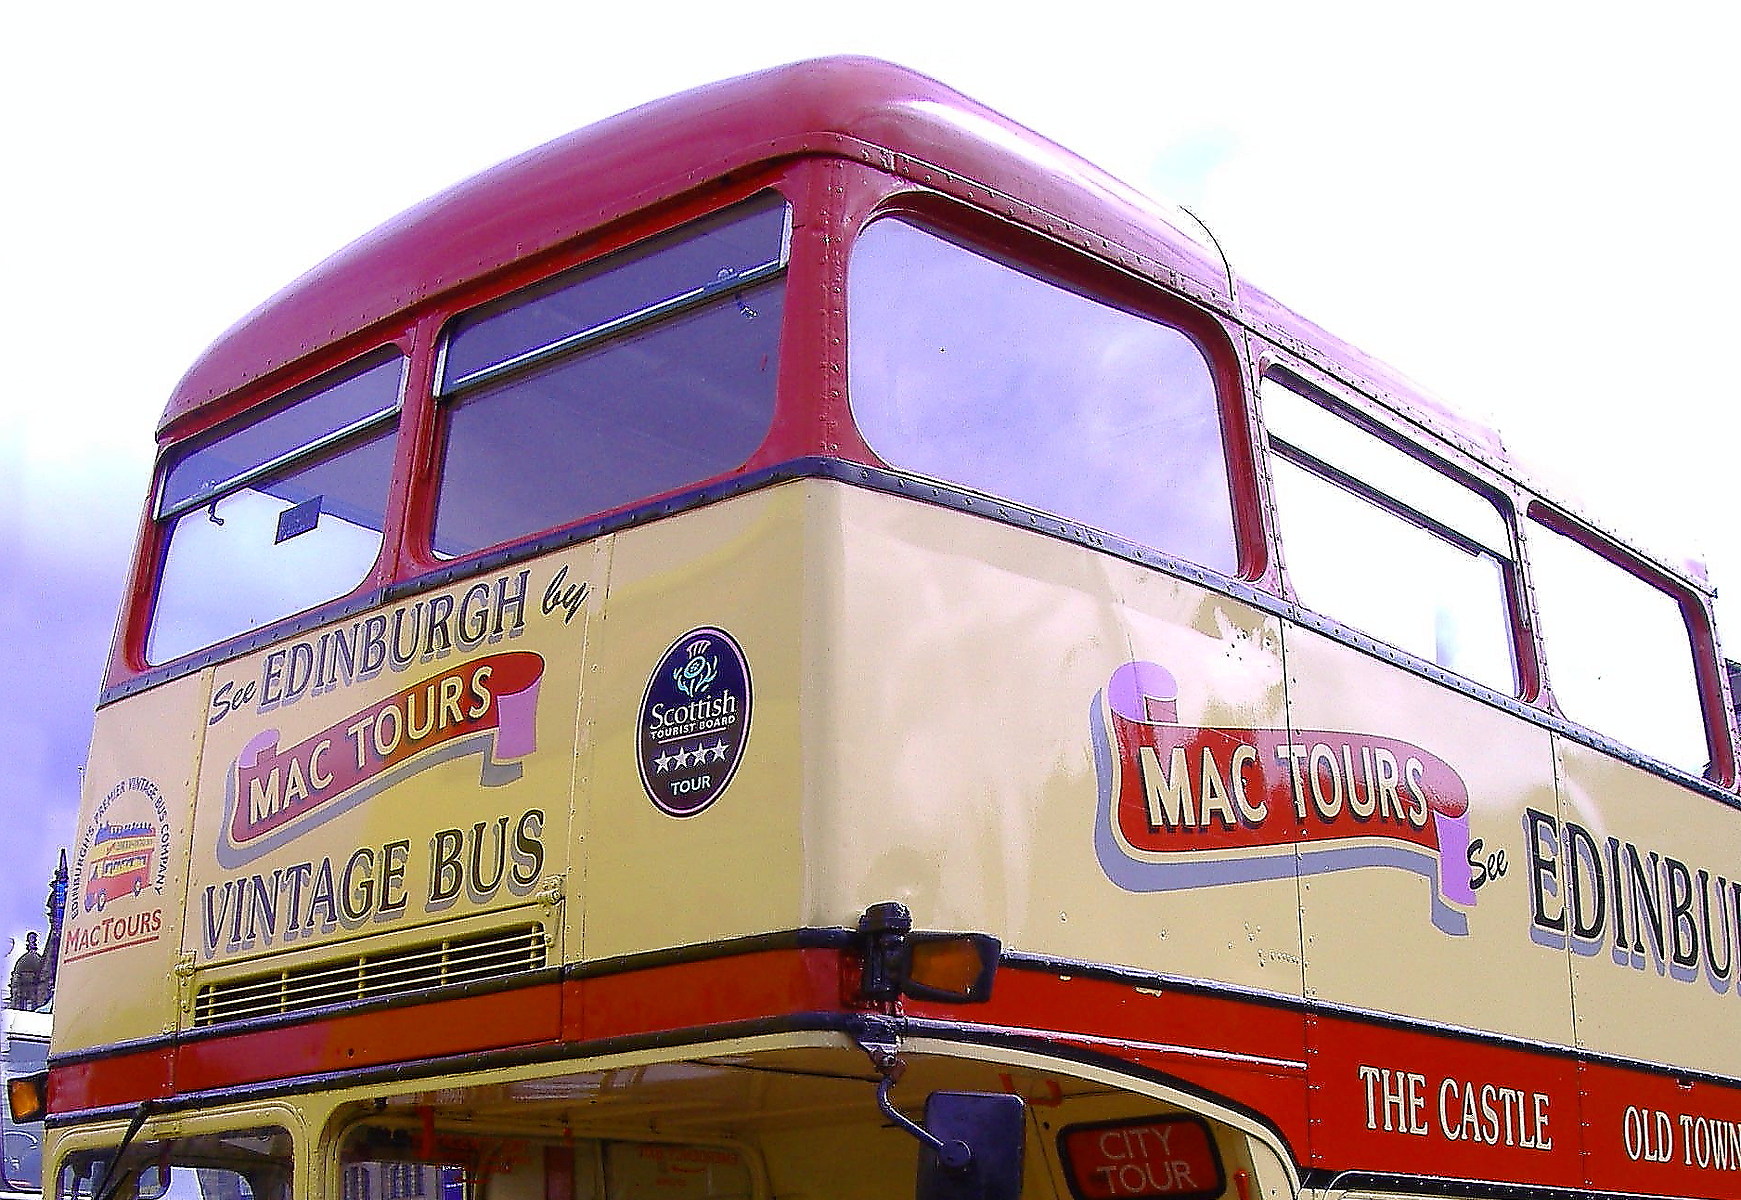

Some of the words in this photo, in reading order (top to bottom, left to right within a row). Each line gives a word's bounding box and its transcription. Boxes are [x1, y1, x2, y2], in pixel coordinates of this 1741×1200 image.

[208, 680, 256, 725] See
[259, 569, 531, 710] EDINBURGH
[541, 564, 590, 624] by
[249, 739, 334, 825] MAC
[348, 665, 494, 769] TOURS
[649, 689, 737, 731] Scottish
[650, 722, 696, 740] TOURIST
[699, 715, 736, 732] BOARD
[670, 775, 712, 796] TOUR
[1138, 745, 1269, 830] MAC
[1276, 743, 1430, 828] TOURS
[154, 824, 169, 896] COMPANY
[204, 839, 411, 952] VINTAGE
[428, 807, 546, 906] BUS
[1466, 838, 1509, 890] See
[1524, 807, 1741, 985] EDINBU
[1100, 1126, 1172, 1160] CITY
[1358, 1065, 1429, 1136] THE
[1439, 1078, 1552, 1150] CASTLE
[1624, 1105, 1673, 1163] OLD
[1096, 1160, 1198, 1194] TOUR
